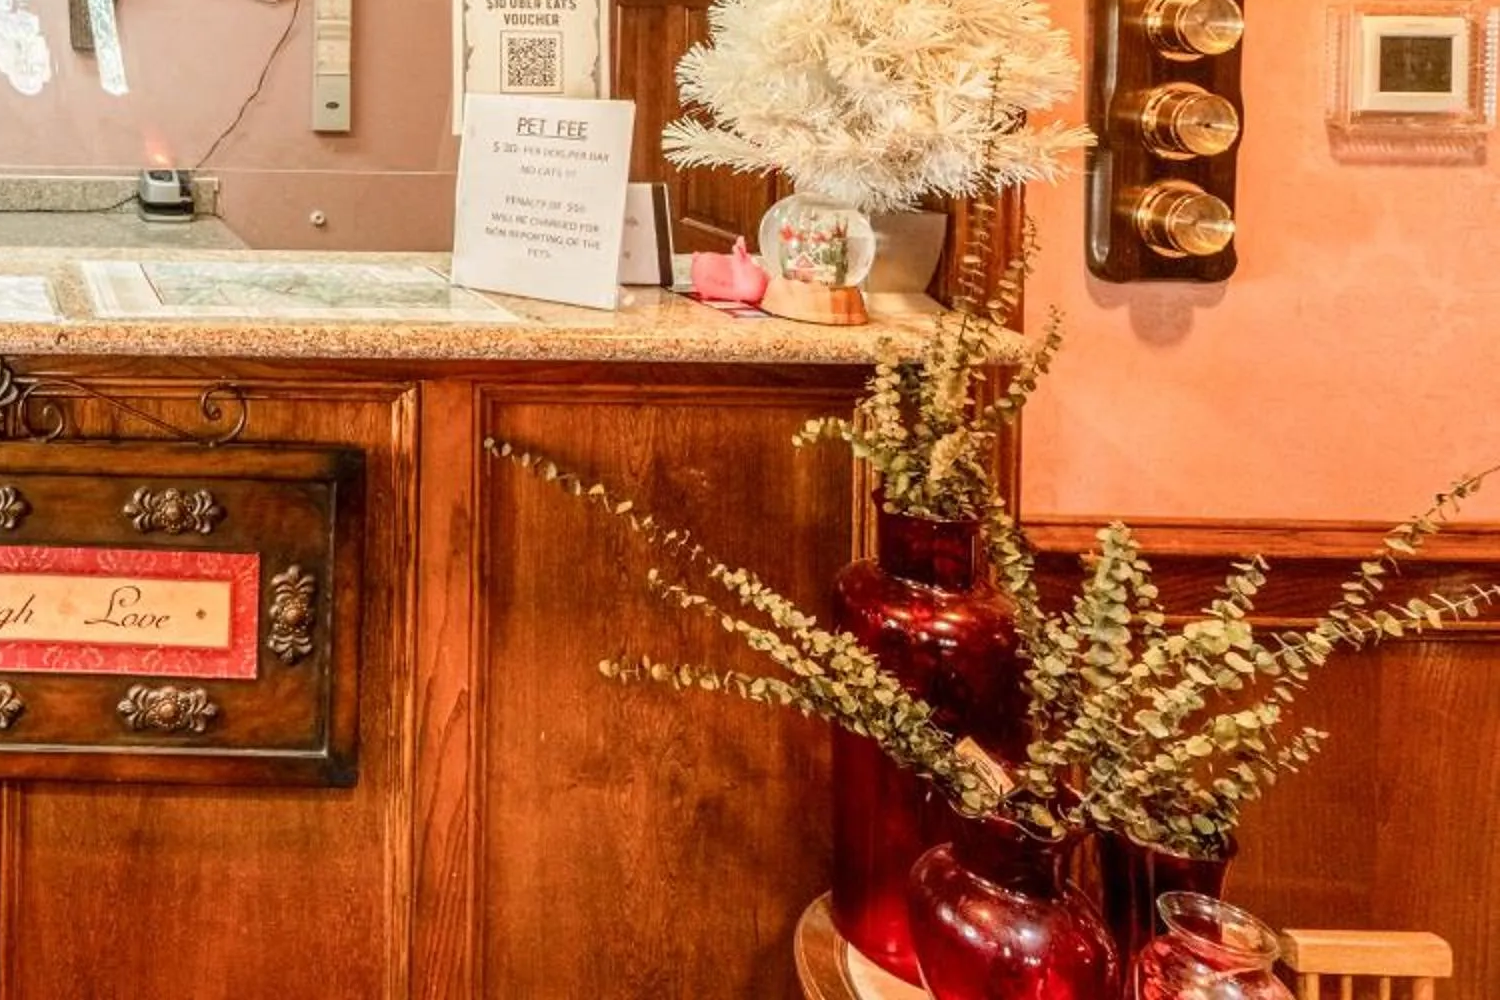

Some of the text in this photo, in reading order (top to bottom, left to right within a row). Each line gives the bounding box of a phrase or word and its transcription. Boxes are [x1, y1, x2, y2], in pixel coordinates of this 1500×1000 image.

[503, 13, 560, 25] VOUCHER
[516, 116, 589, 137] PET FEE
[505, 194, 547, 208] PENALTY
[491, 211, 513, 222] WILL
[529, 216, 579, 231] CHARGED
[580, 222, 600, 233] FOR
[507, 229, 564, 245] REPORTING
[565, 236, 580, 247] OF
[582, 239, 602, 250] THE
[84, 585, 171, 630] Love
